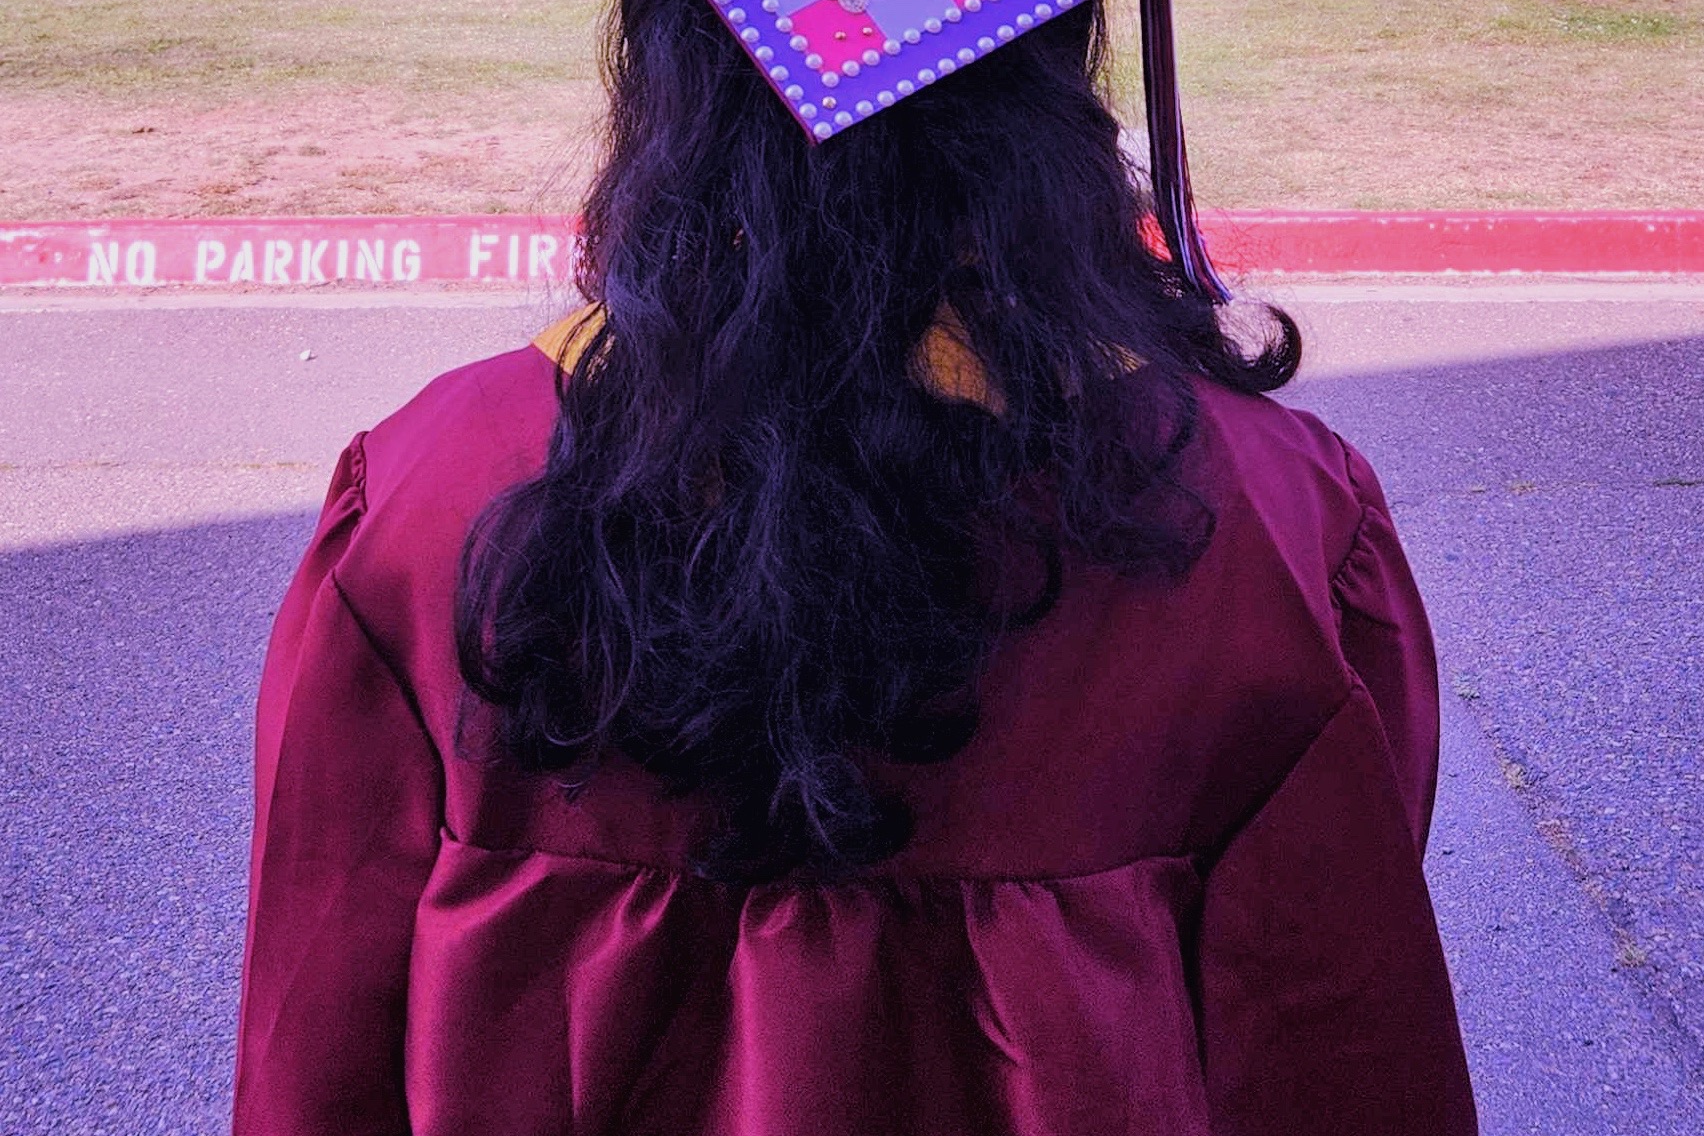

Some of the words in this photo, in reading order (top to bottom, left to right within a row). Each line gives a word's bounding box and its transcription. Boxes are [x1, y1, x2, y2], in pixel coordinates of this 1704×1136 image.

[88, 240, 156, 285] NO
[195, 239, 422, 284] PARKING
[468, 233, 577, 280] FIR
